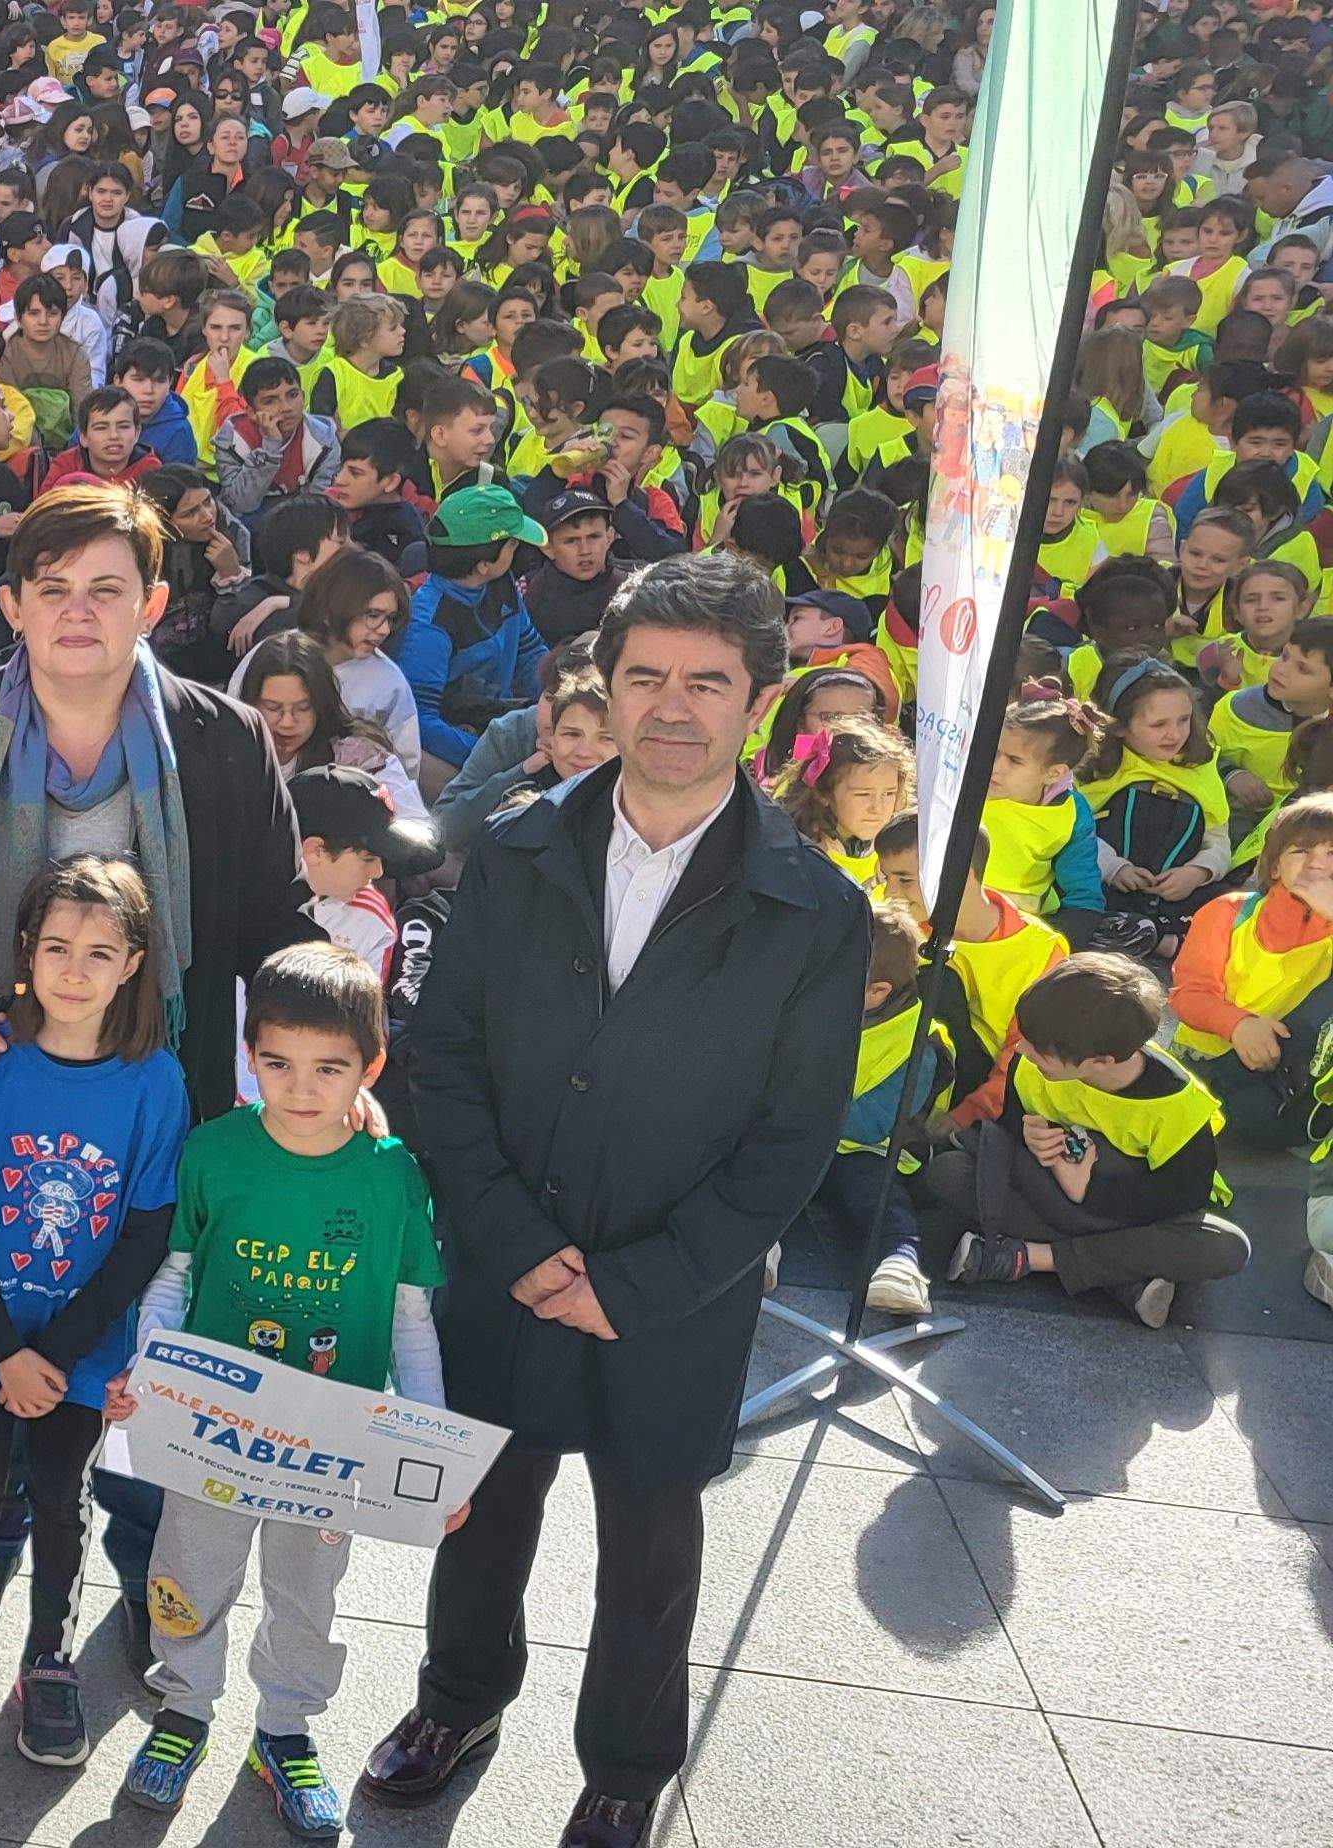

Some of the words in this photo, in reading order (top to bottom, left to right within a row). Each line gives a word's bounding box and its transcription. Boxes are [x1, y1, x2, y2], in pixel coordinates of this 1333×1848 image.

[308, 1251, 337, 1271] EL
[251, 1266, 340, 1292] PARQUE
[155, 1346, 246, 1383] REGALO
[149, 1380, 203, 1410] VALE
[208, 1404, 255, 1433] POR
[261, 1426, 311, 1450] UNA
[387, 1408, 474, 1440] ASPACE
[191, 1411, 365, 1481] TABLET
[167, 1442, 194, 1458] PARA
[197, 1455, 247, 1479] RECOGER
[249, 1473, 264, 1484] EN
[269, 1479, 282, 1488] C/
[285, 1481, 323, 1496] TERUEL
[238, 1490, 334, 1519] XERYO
